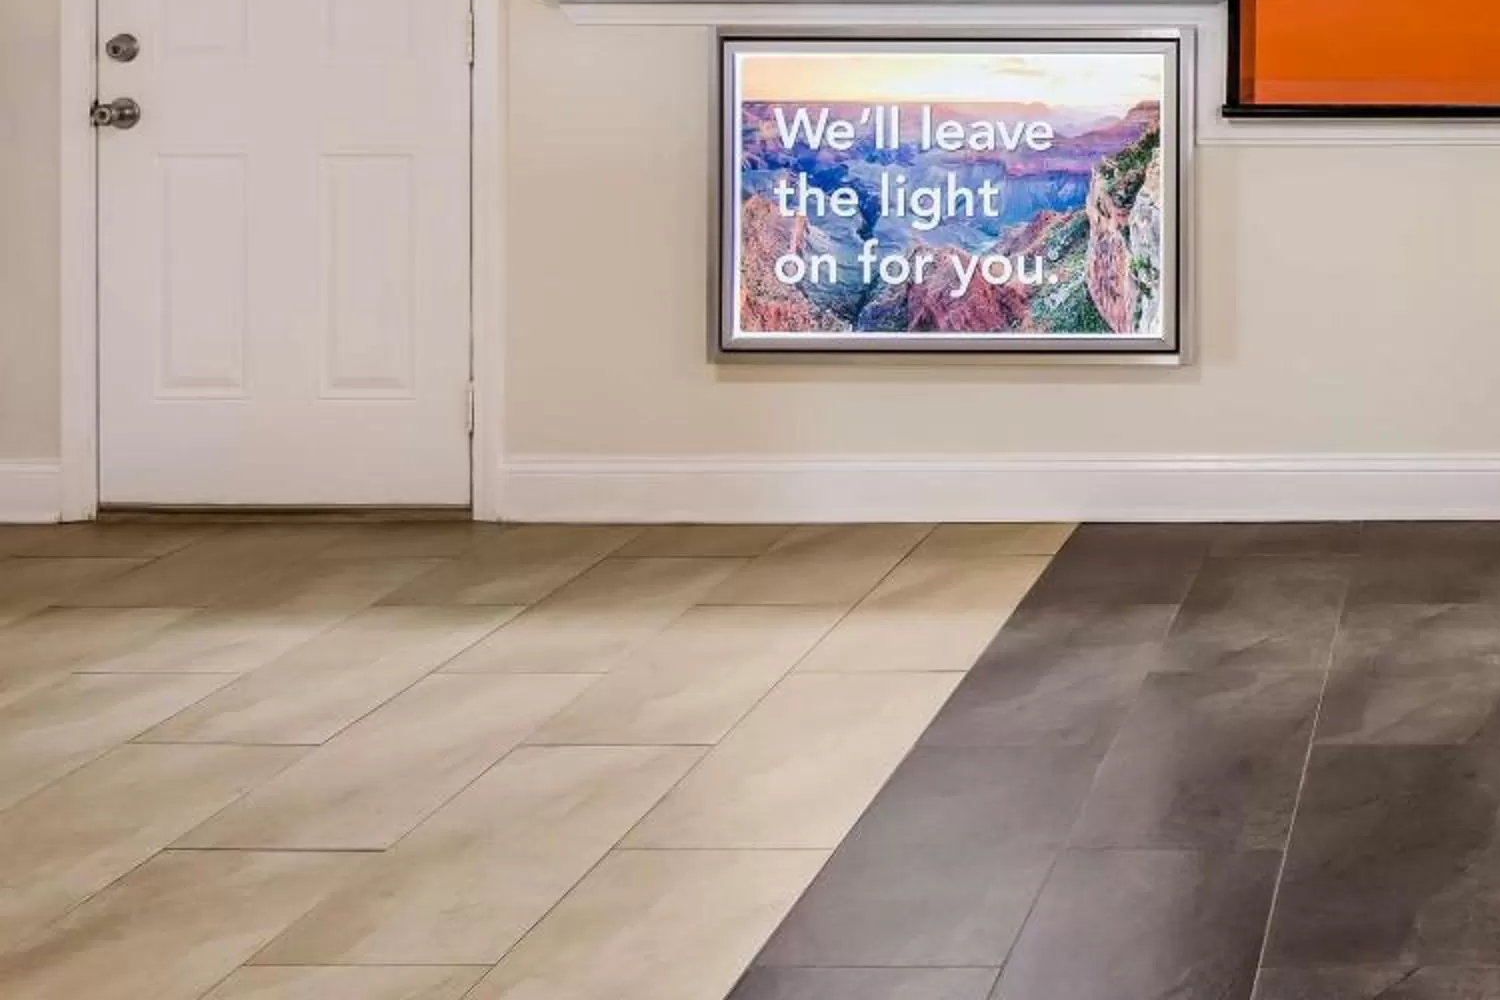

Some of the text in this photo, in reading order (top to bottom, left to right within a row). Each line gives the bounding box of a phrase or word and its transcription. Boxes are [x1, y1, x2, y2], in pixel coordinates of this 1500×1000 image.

[774, 105, 1055, 151] We'll leave
[774, 171, 1000, 230] the light
[774, 238, 1060, 298] on for you.
